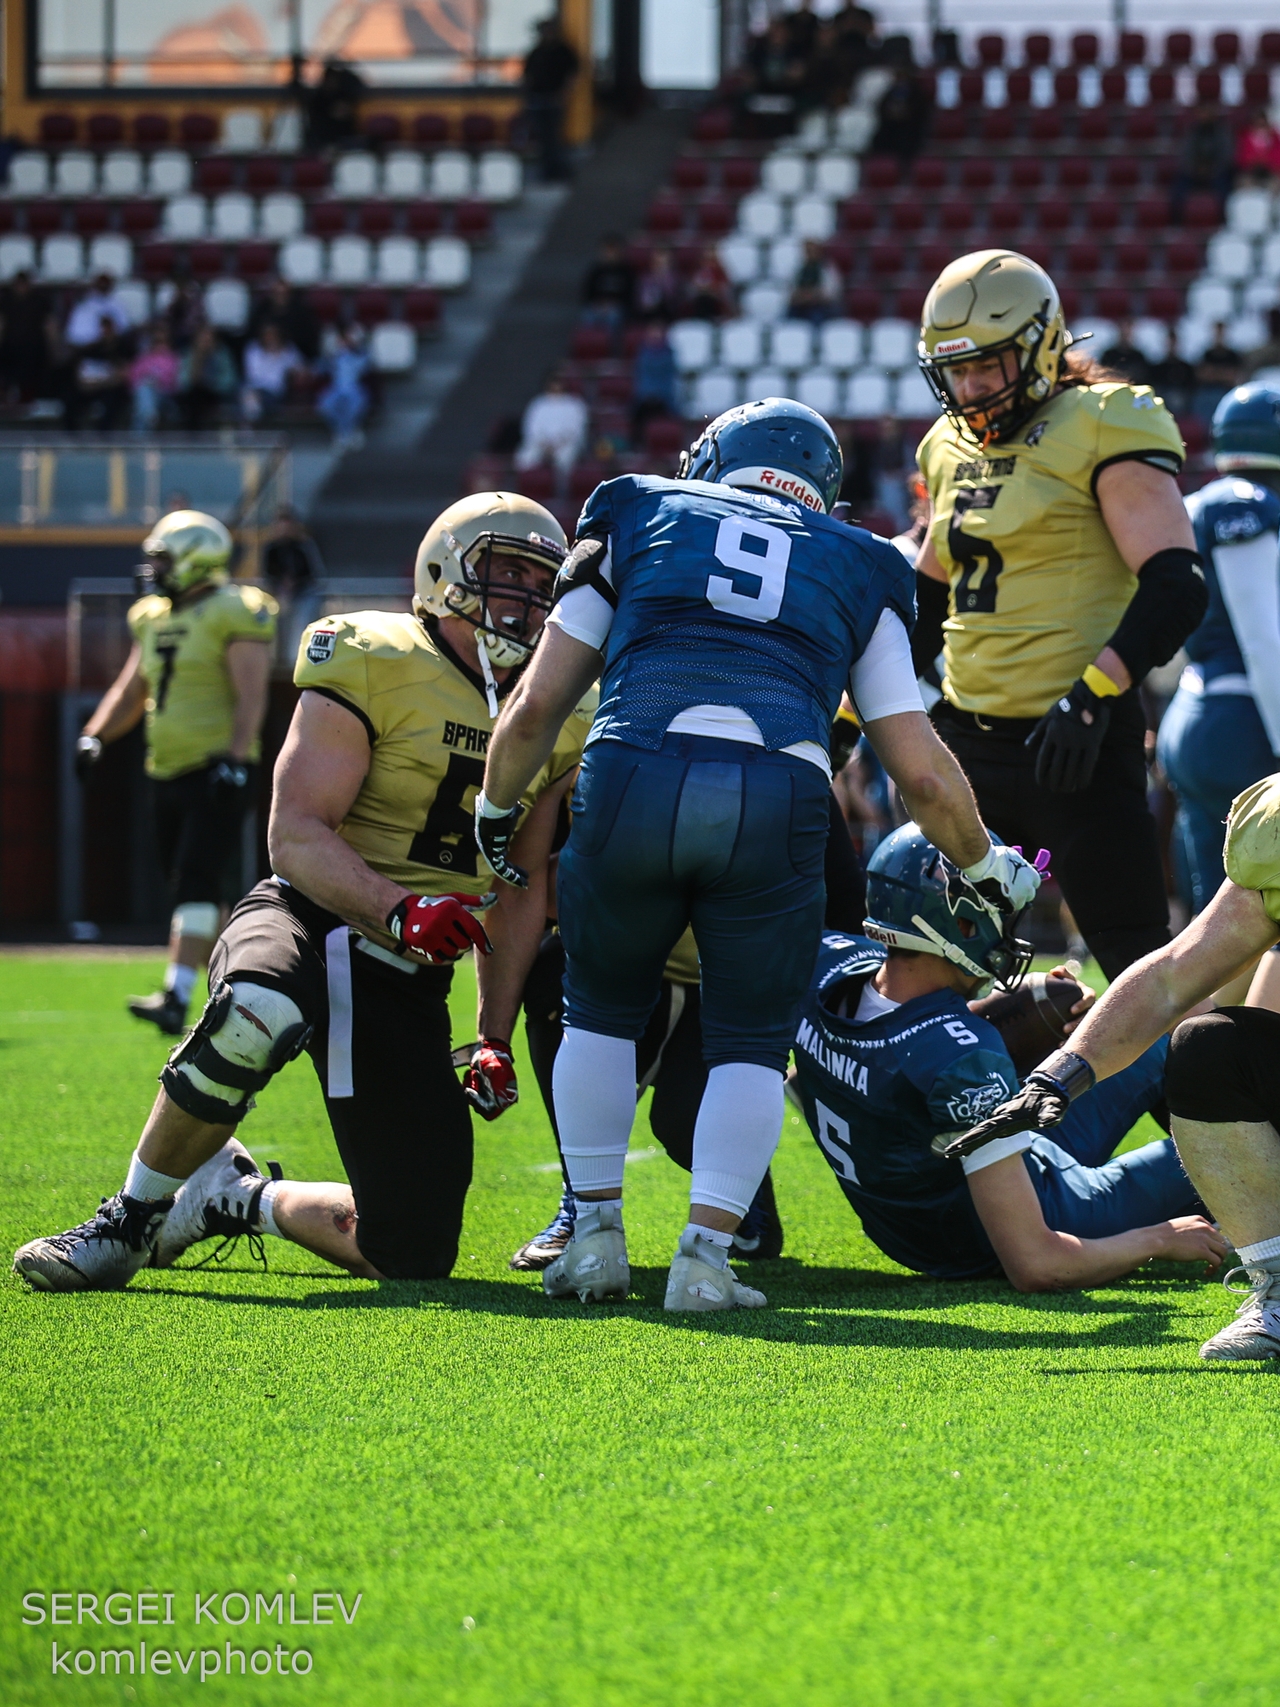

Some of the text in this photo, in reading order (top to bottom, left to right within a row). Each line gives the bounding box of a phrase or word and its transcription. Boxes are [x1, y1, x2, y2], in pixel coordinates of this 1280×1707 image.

[760, 470, 823, 512] Riddell
[706, 514, 793, 623] 9
[795, 1017, 869, 1096] MALINKA
[943, 1020, 979, 1046] 5
